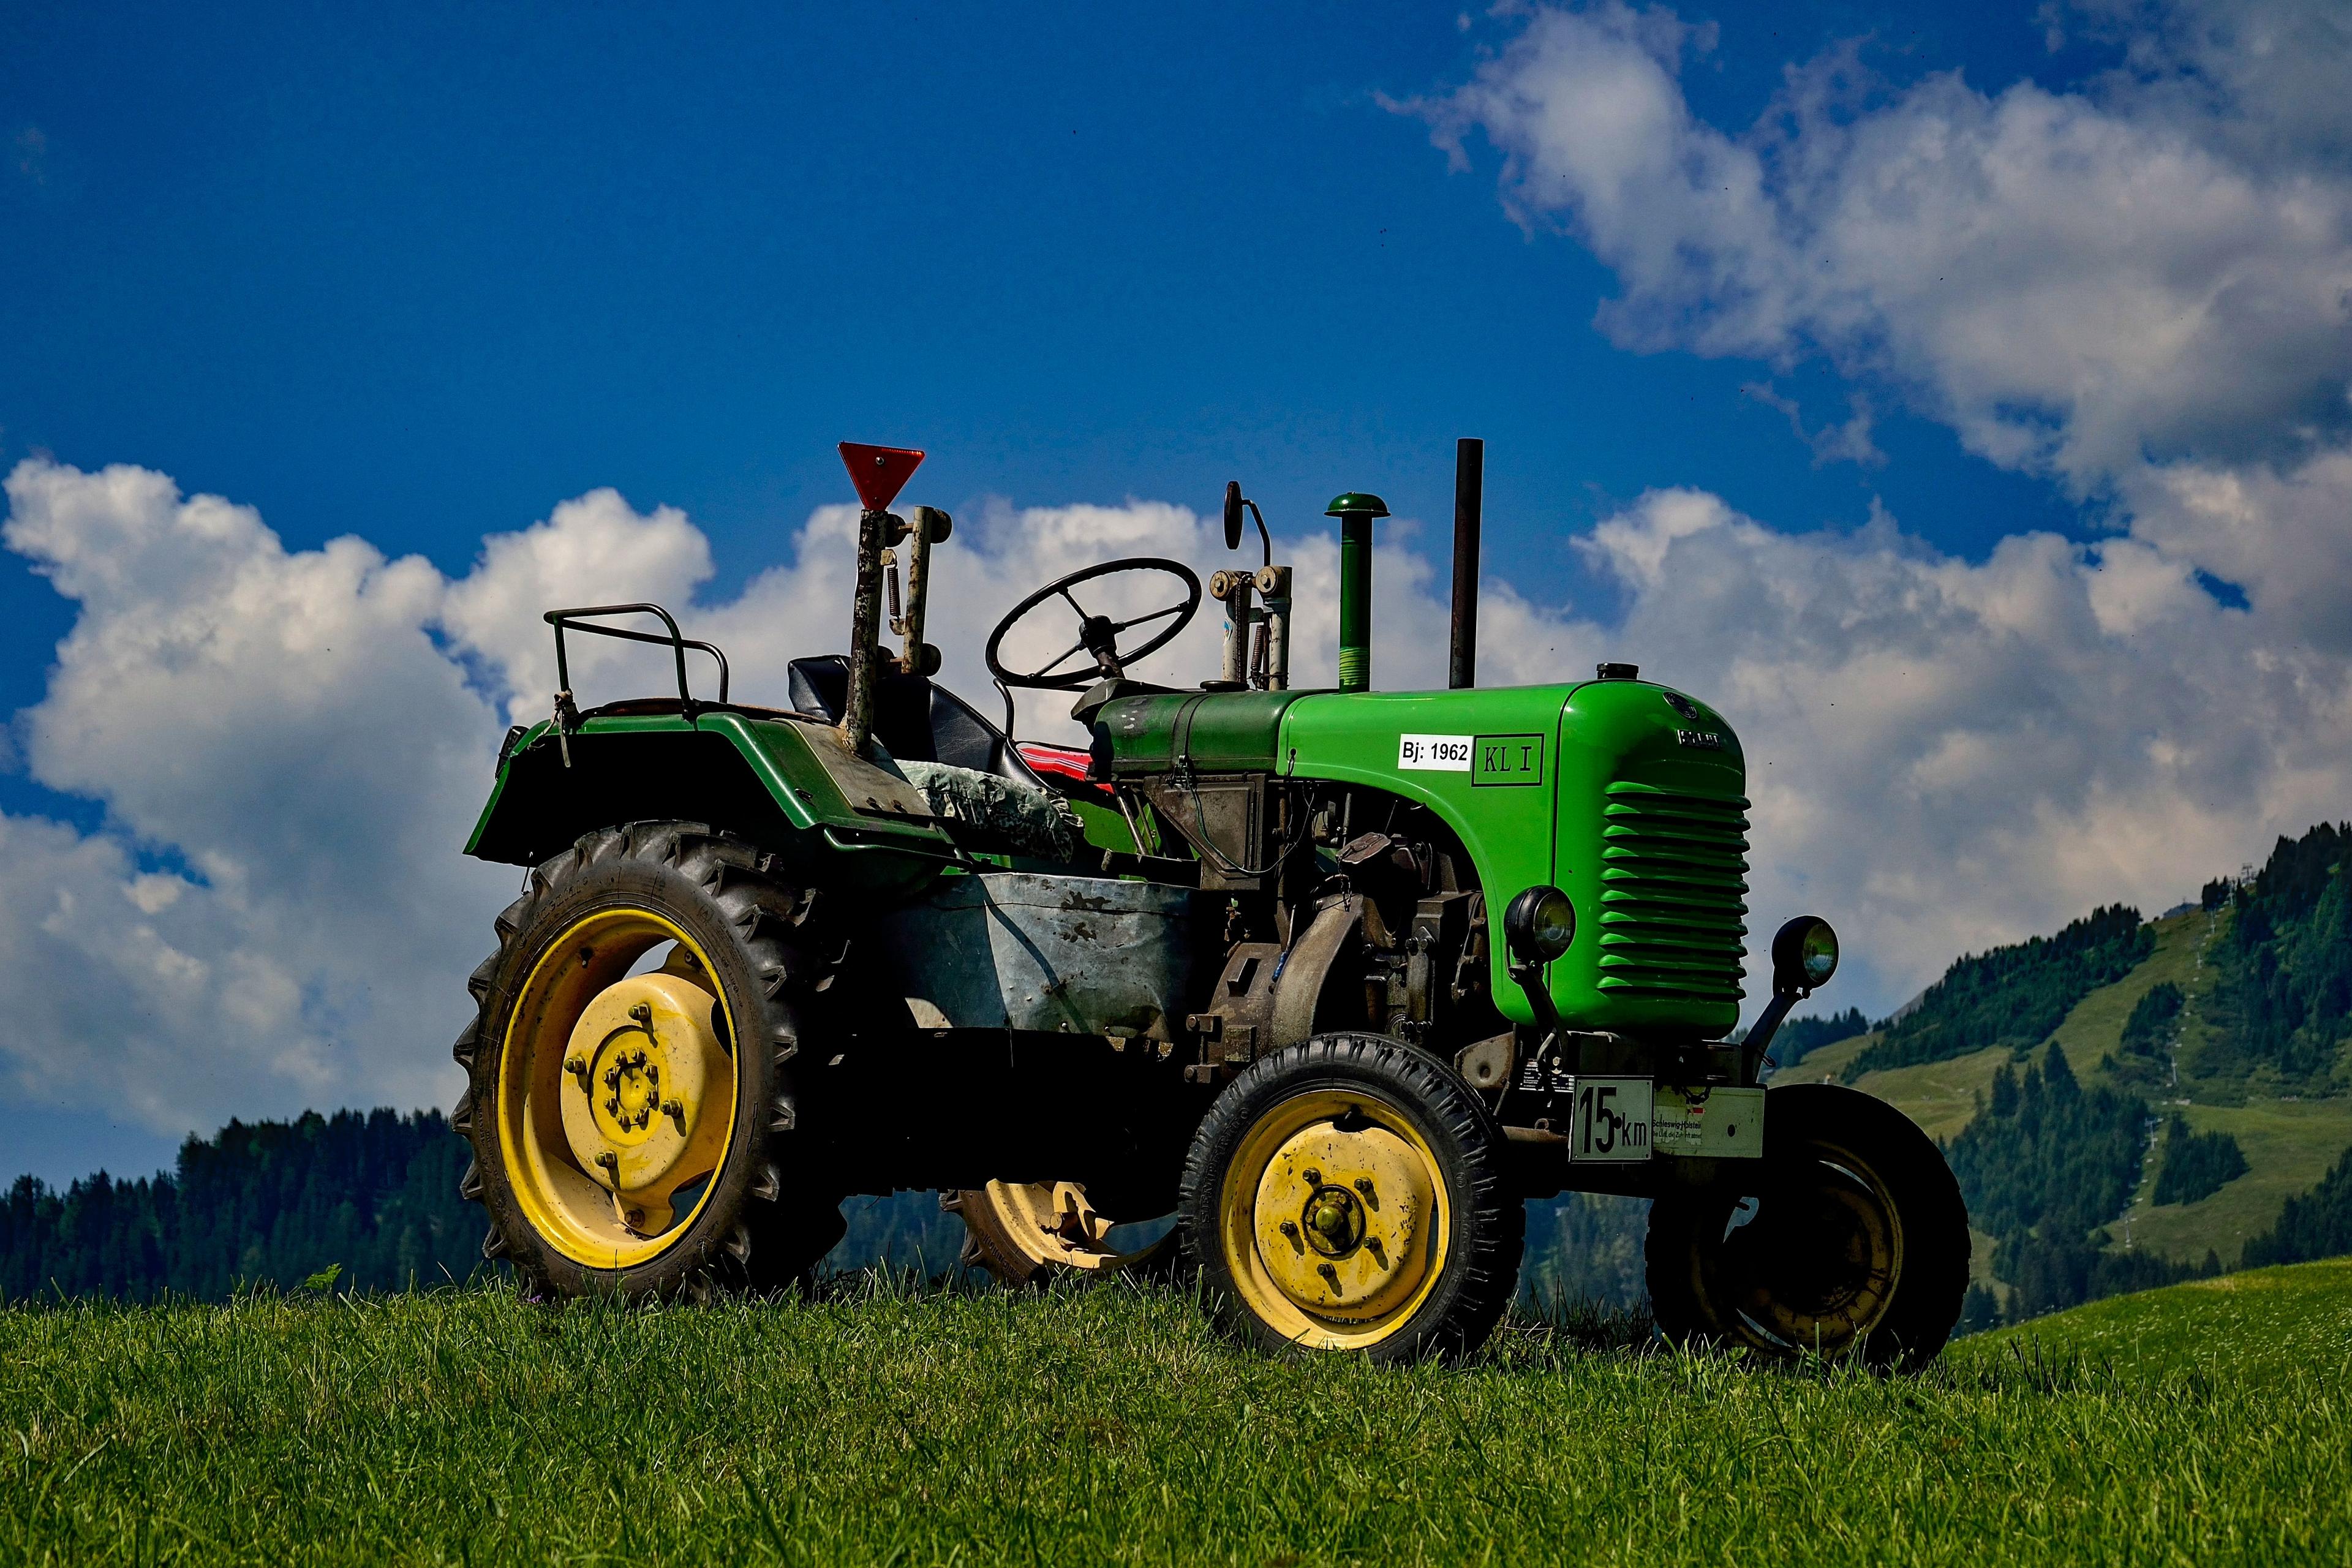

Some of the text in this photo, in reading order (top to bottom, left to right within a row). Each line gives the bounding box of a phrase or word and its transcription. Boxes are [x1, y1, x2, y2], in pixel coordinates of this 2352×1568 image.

[1403, 742, 1468, 763] Bj: 1962
[1484, 747, 1511, 772] KL
[1578, 1086, 1647, 1153] 15 km
